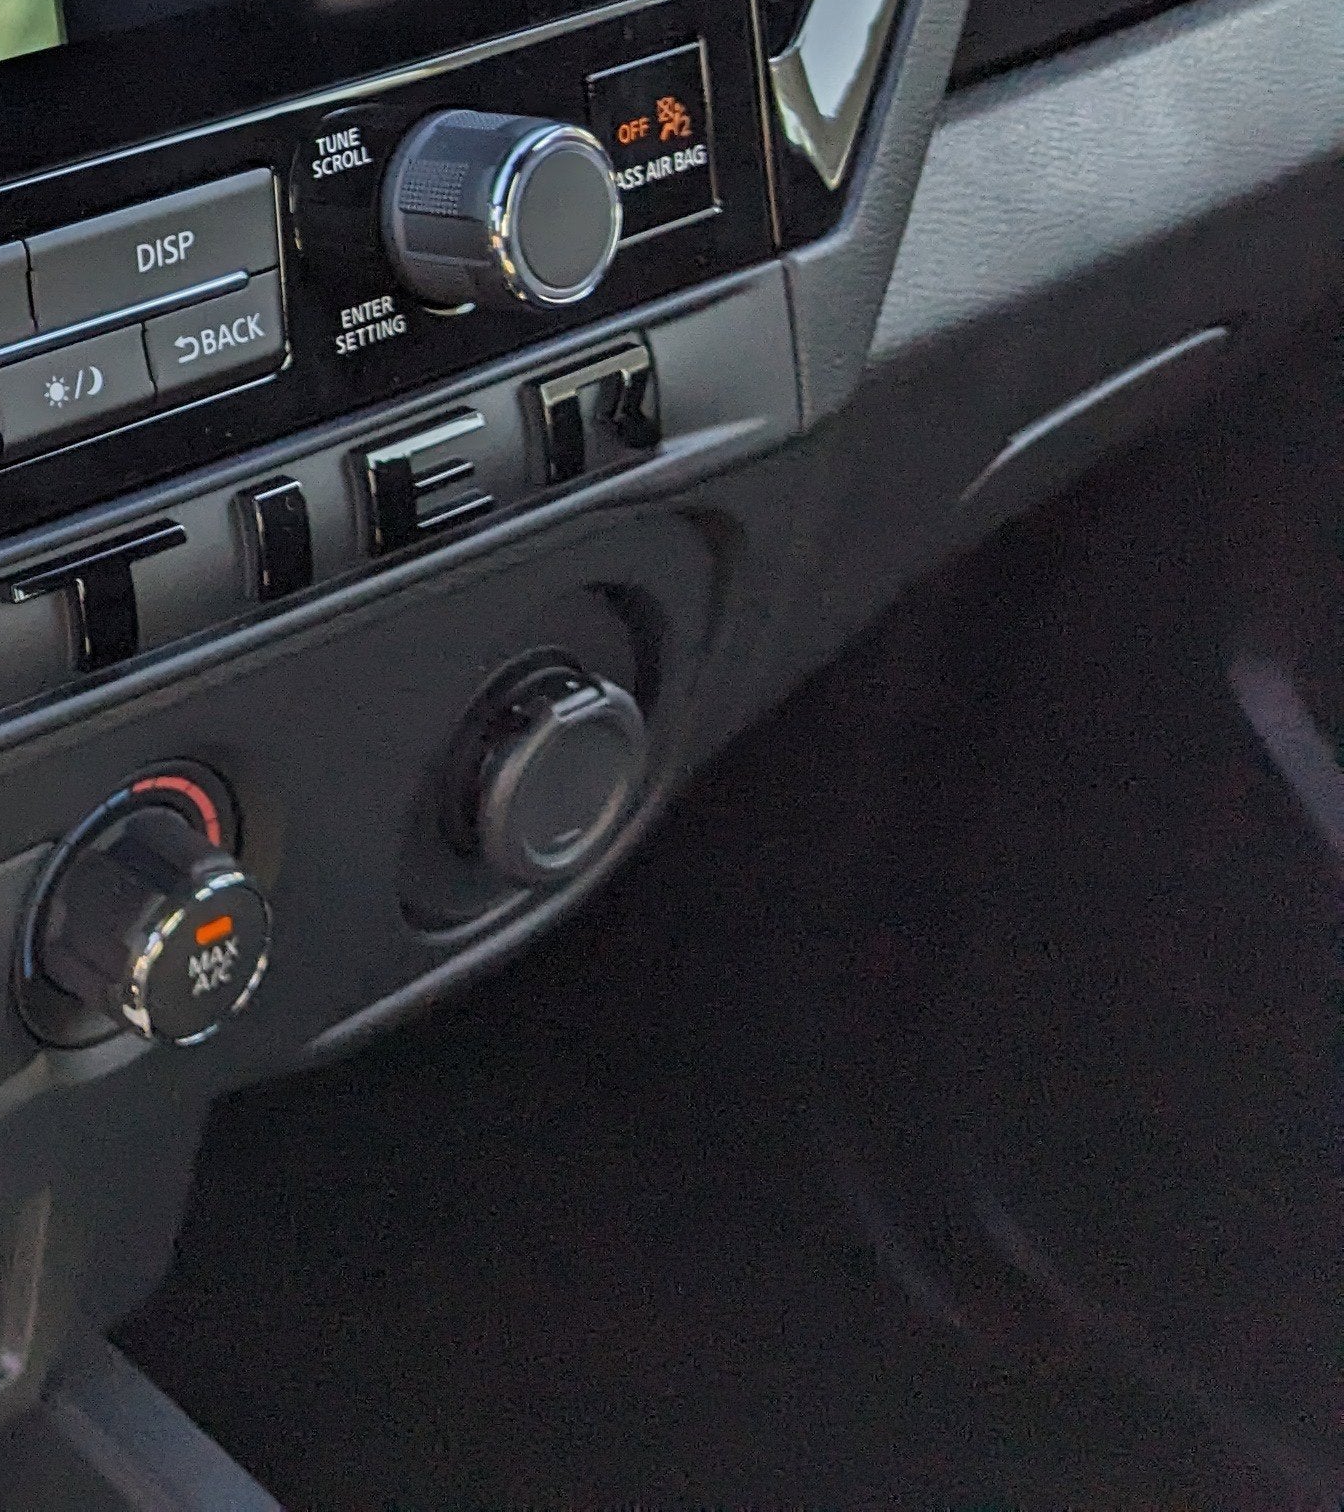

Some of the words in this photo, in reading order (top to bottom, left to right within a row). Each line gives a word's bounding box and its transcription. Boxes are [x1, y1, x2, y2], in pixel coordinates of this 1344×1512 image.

[315, 127, 360, 157] TUNE
[618, 117, 650, 144] OFF
[313, 146, 372, 179] SCROLL
[614, 165, 645, 190] ASS
[646, 155, 674, 182] AIR
[674, 144, 708, 172] BAG
[136, 230, 195, 273] DISP
[341, 296, 393, 329] ENTER
[201, 313, 265, 357] BACK
[335, 315, 407, 355] SETTING
[189, 936, 238, 979] MAX
[193, 965, 231, 996] A/C
